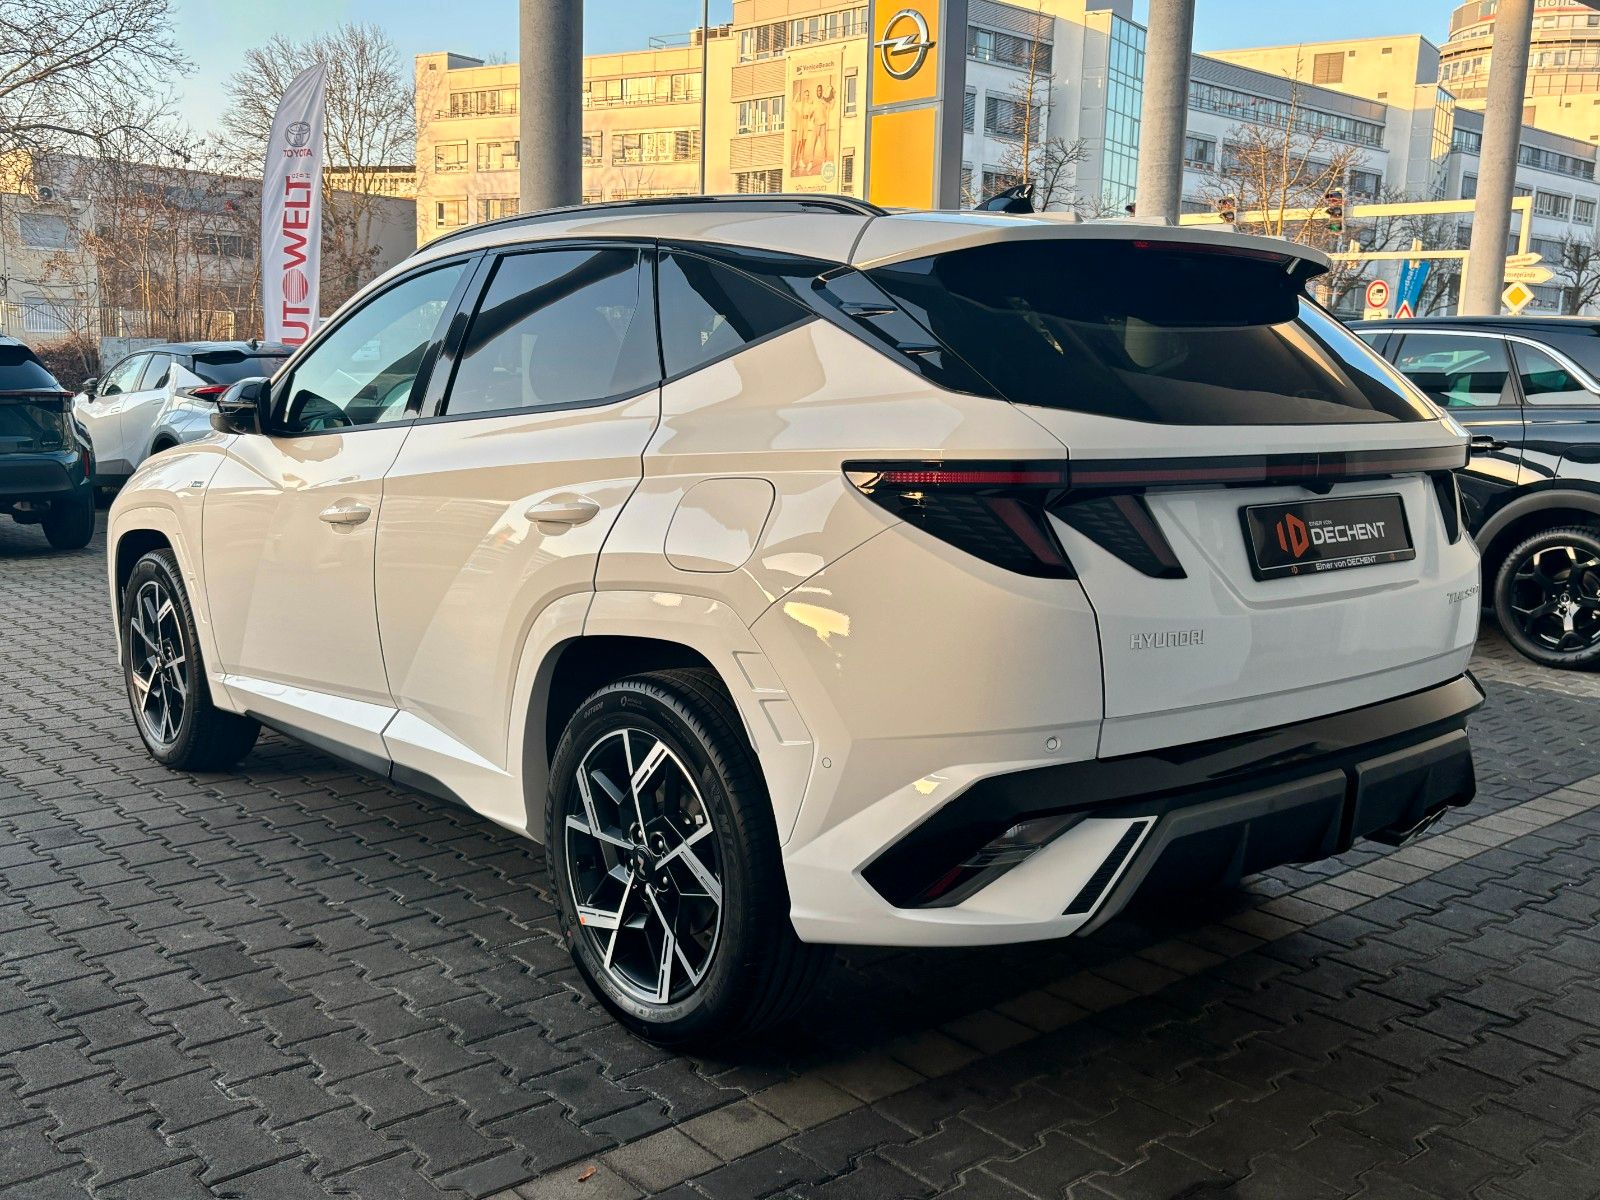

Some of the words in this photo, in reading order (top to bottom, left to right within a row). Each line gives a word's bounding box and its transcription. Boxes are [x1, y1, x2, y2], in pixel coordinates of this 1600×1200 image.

[283, 148, 313, 158] TOYOTA
[281, 175, 312, 347] UTOWELT
[1311, 522, 1385, 544] DECHENT
[1315, 562, 1333, 571] Einer
[1334, 560, 1347, 569] von
[1347, 556, 1376, 566] DECHENT
[1130, 629, 1204, 649] HYUNDAI
